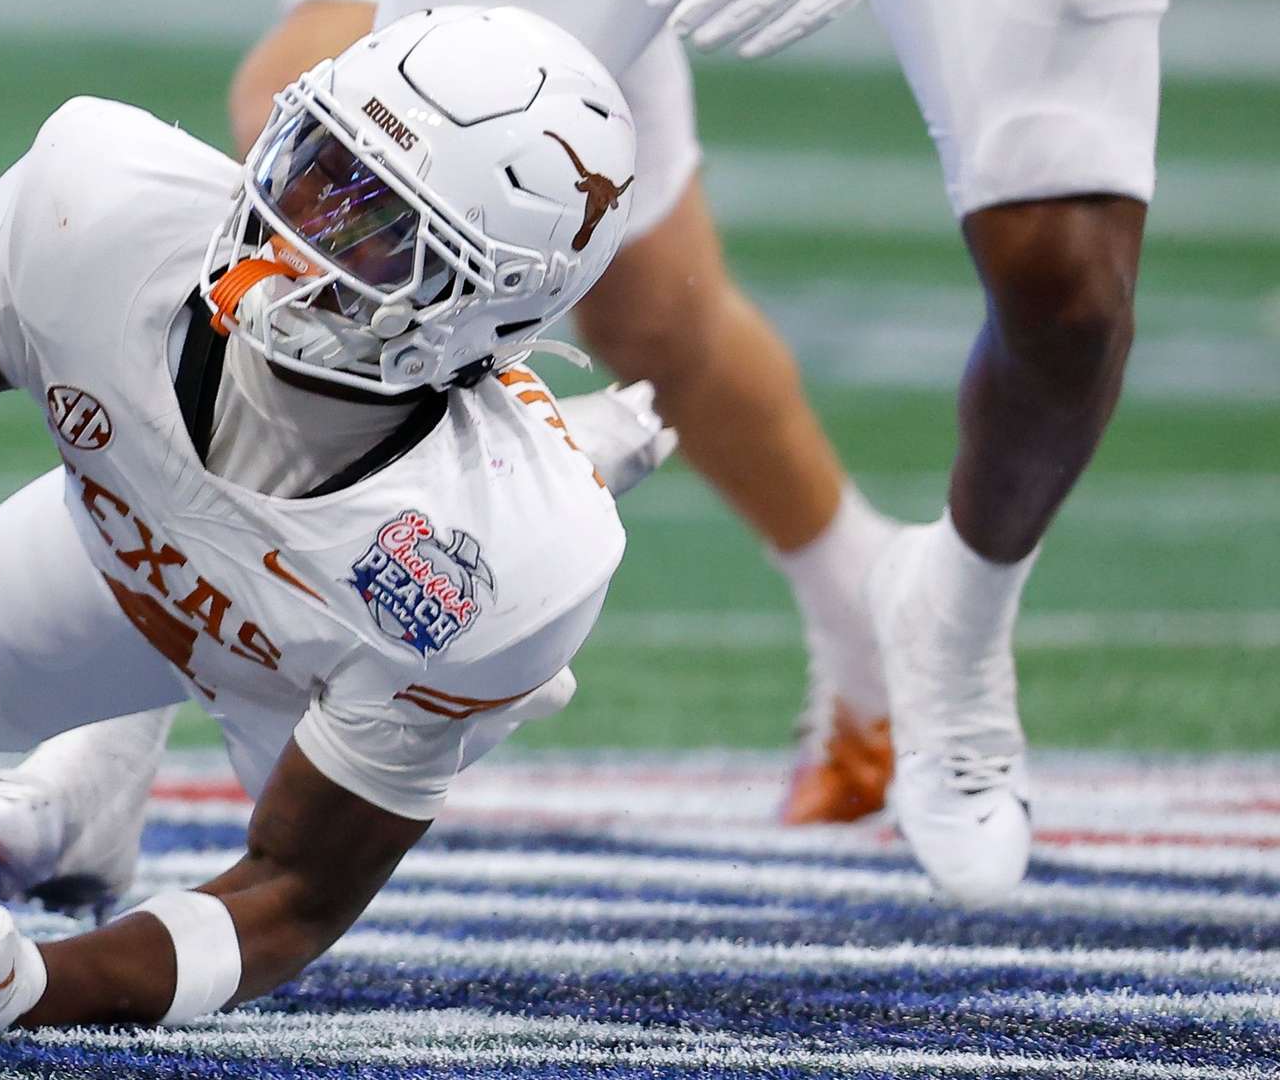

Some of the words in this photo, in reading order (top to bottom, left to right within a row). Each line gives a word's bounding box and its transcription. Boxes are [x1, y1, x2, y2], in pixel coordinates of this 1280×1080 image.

[361, 96, 419, 152] HORNS
[48, 386, 112, 450] SEC
[65, 461, 282, 671] EXAS
[352, 544, 460, 648] PEACH
[367, 581, 419, 639] BOWL
